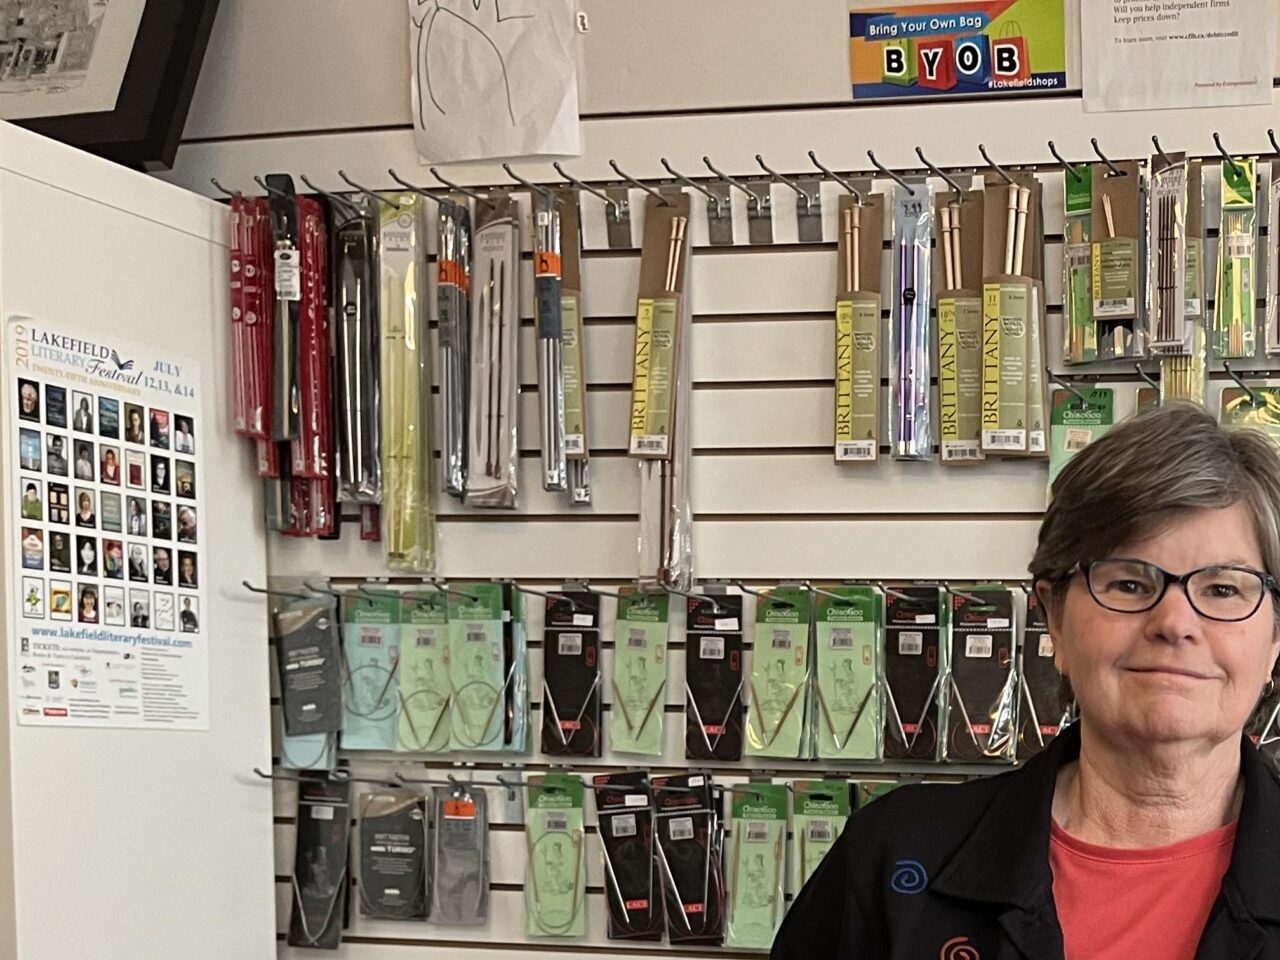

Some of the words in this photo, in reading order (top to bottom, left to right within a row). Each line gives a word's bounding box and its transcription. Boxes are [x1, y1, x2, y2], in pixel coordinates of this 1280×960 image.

[870, 24, 898, 36] Bring
[901, 21, 926, 32] Your
[930, 17, 956, 30] Own
[960, 15, 982, 29] Bag
[1113, 5, 1127, 14] Will
[1129, 6, 1143, 14] you
[1144, 3, 1161, 14] help
[1162, 2, 1208, 12] independent
[1114, 15, 1131, 24] keep
[1133, 13, 1154, 24] prices
[1156, 12, 1180, 21] down?
[988, 77, 1058, 89] #Lakefieldshops
[16, 325, 29, 368] 2019
[32, 329, 109, 359] LAKEFIELD
[32, 344, 86, 369] LITERARY
[85, 359, 144, 386] Festival
[153, 360, 183, 377] JULY
[632, 327, 651, 430] BRITTANY
[838, 331, 851, 436] BRITTANY
[940, 328, 957, 436] BRITTANY
[983, 314, 999, 425] BRITTANY
[32, 626, 193, 648] www.lakefieldliteraryfestival.com
